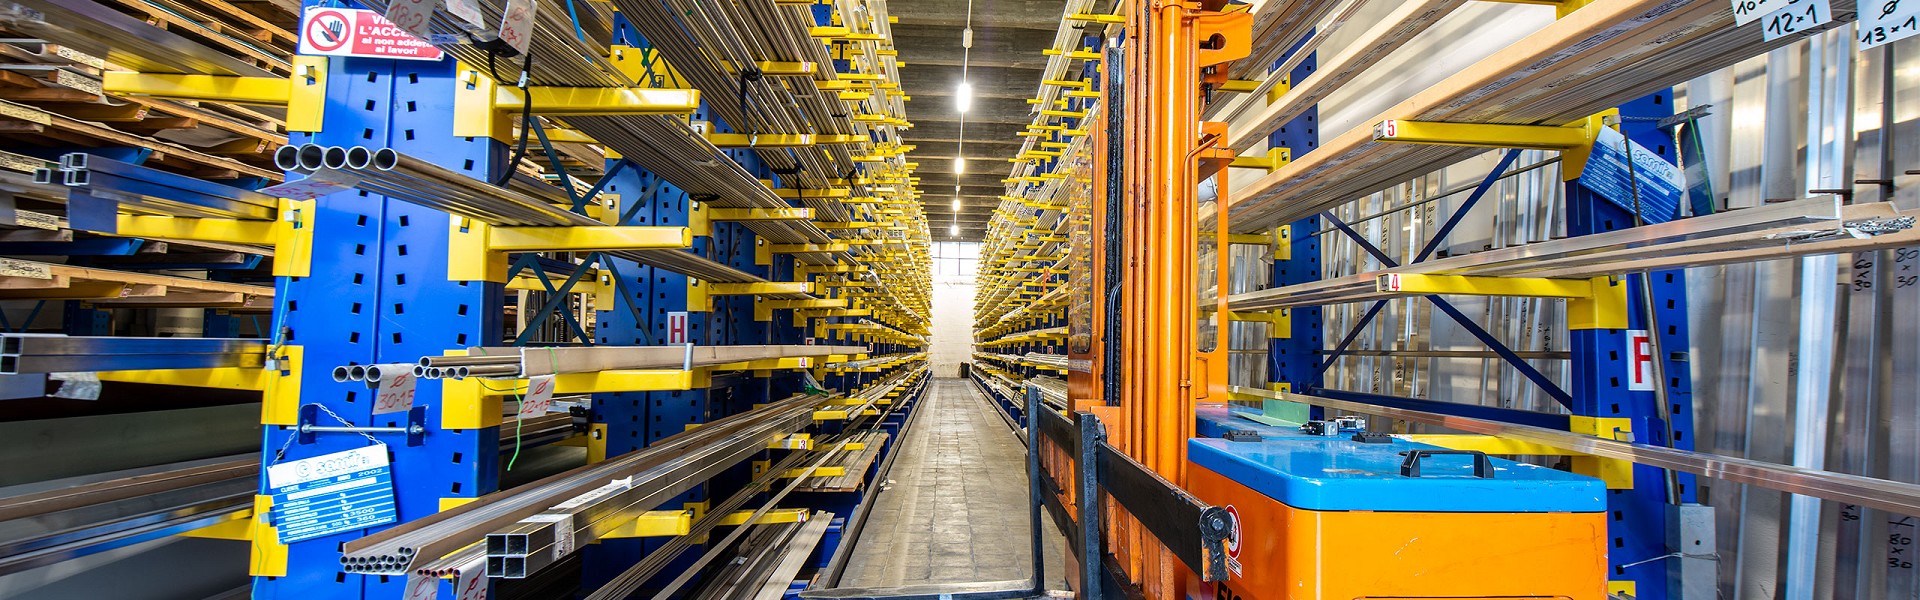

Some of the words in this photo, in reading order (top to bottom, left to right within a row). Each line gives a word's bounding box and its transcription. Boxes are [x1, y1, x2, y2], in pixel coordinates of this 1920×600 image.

[388, 46, 418, 55] lavori
[1388, 120, 1395, 136] 5
[1392, 274, 1399, 291] 4
[670, 316, 685, 343] H
[801, 440, 806, 450] 3
[358, 468, 382, 477] 2002
[800, 512, 805, 522] 2
